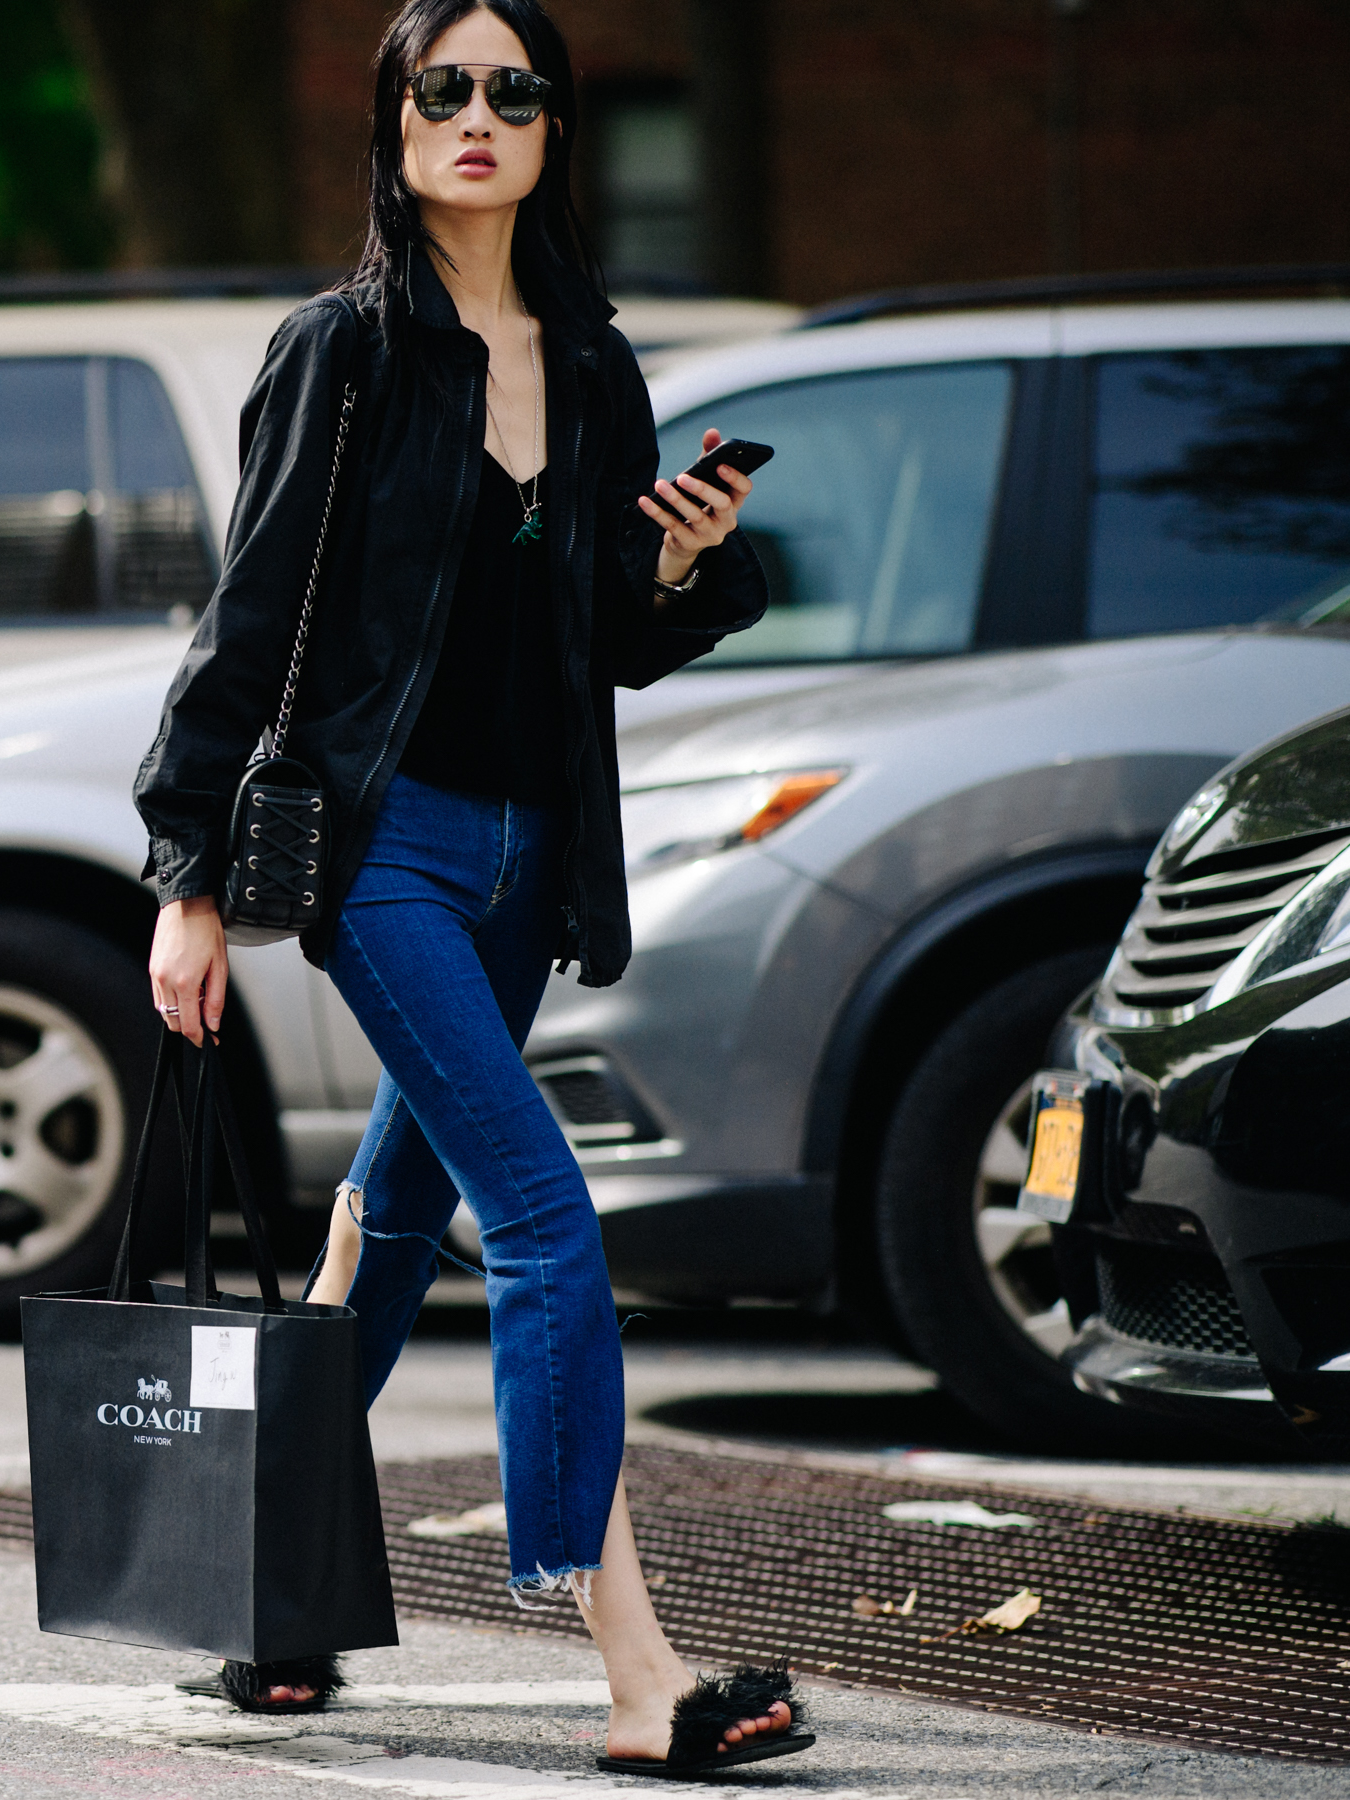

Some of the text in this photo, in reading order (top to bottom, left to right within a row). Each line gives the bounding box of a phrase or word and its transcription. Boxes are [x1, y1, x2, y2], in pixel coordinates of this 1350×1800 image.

[97, 1403, 202, 1434] COACH
[134, 1435, 172, 1446] NEW YORK
